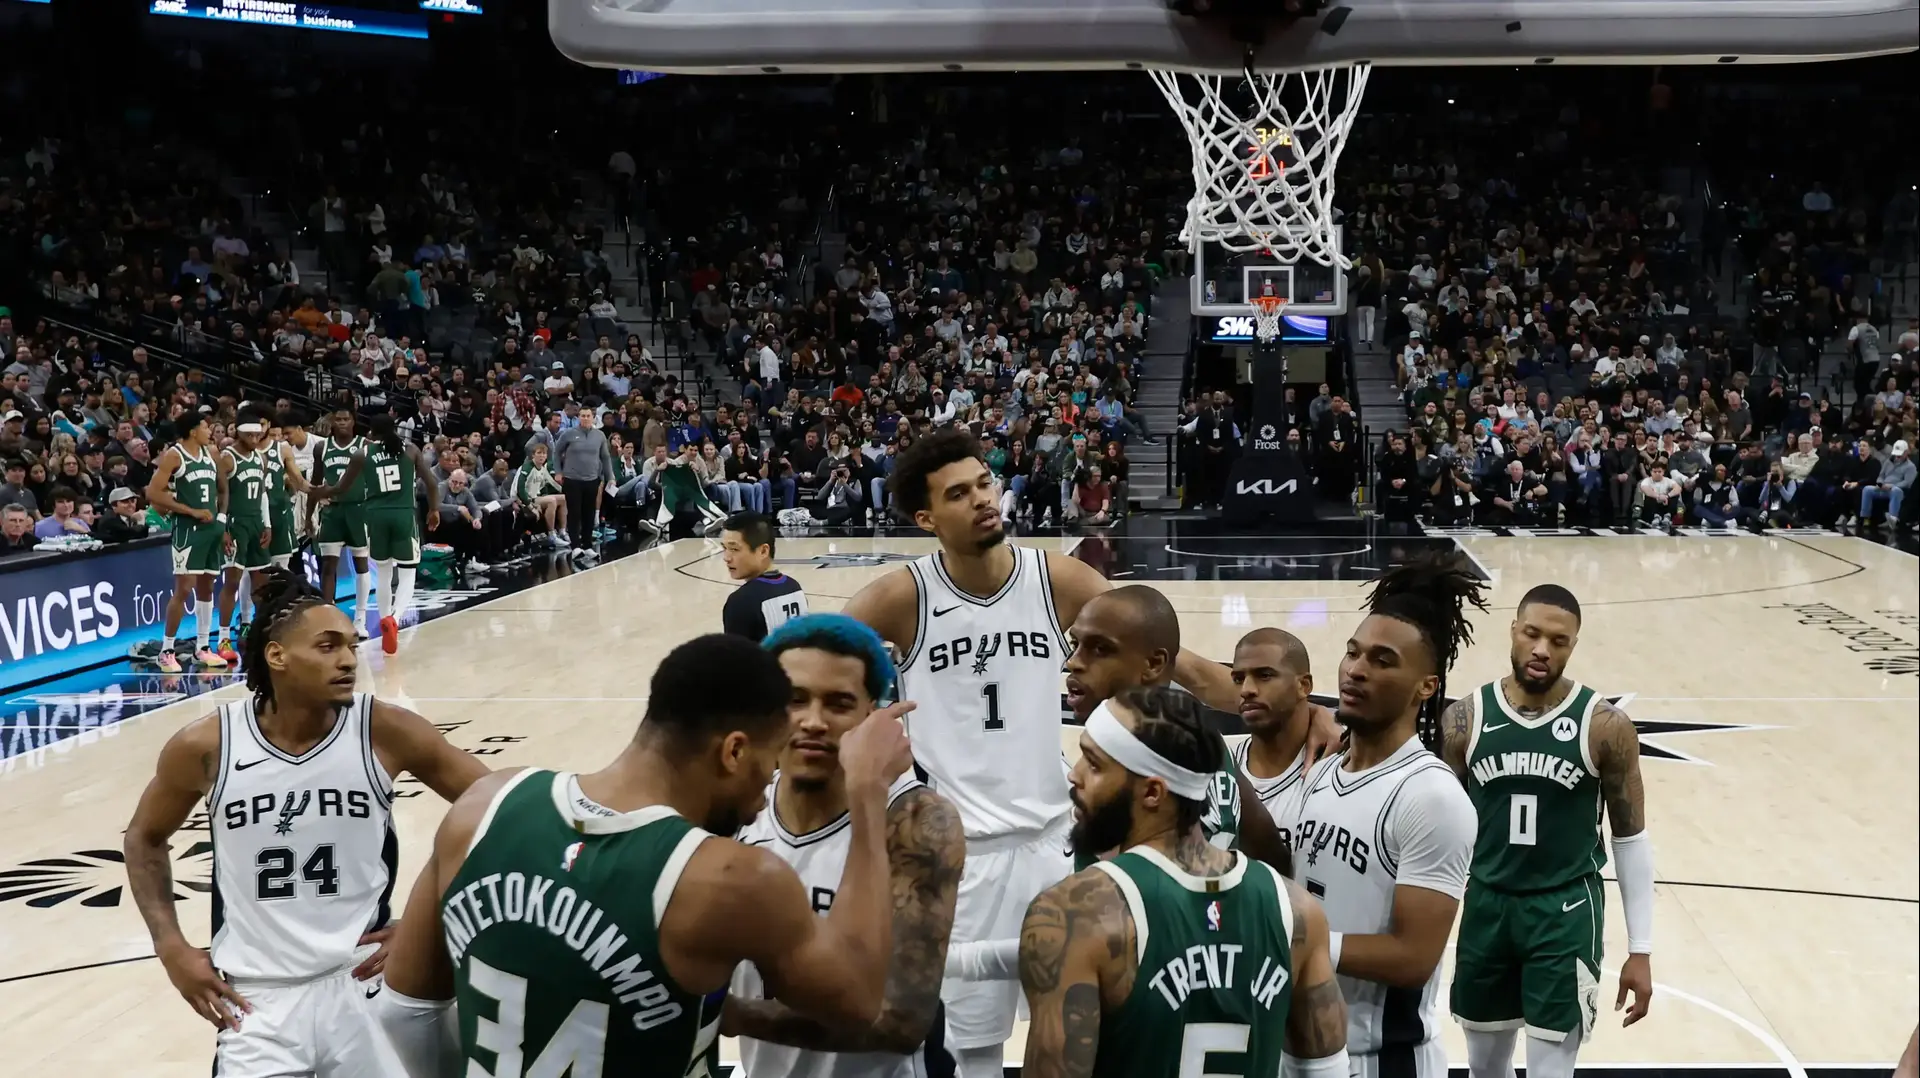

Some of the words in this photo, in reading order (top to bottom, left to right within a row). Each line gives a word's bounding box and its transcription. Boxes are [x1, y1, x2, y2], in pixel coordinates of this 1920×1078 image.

[206, 7, 238, 19] PLAN
[240, 10, 297, 25] SERVICES
[223, 0, 296, 14] RETIREMENT
[303, 14, 356, 29] business.
[1254, 439, 1281, 450] Frost
[200, 483, 209, 502] 3
[247, 481, 260, 499] 17
[376, 464, 402, 492] 12
[1236, 479, 1297, 494] KIA
[133, 584, 162, 627] for
[929, 631, 1050, 676] SPURS
[981, 682, 1006, 732] 1
[1471, 751, 1585, 791] MILWAUKEE
[224, 788, 370, 837] SPURS
[1509, 793, 1538, 846] 0
[255, 843, 340, 901] 24
[442, 871, 683, 1032] ANTETOKOUNMPO
[1148, 943, 1243, 1012] TRENT
[1250, 955, 1289, 1011] JR
[464, 954, 611, 1078] 34
